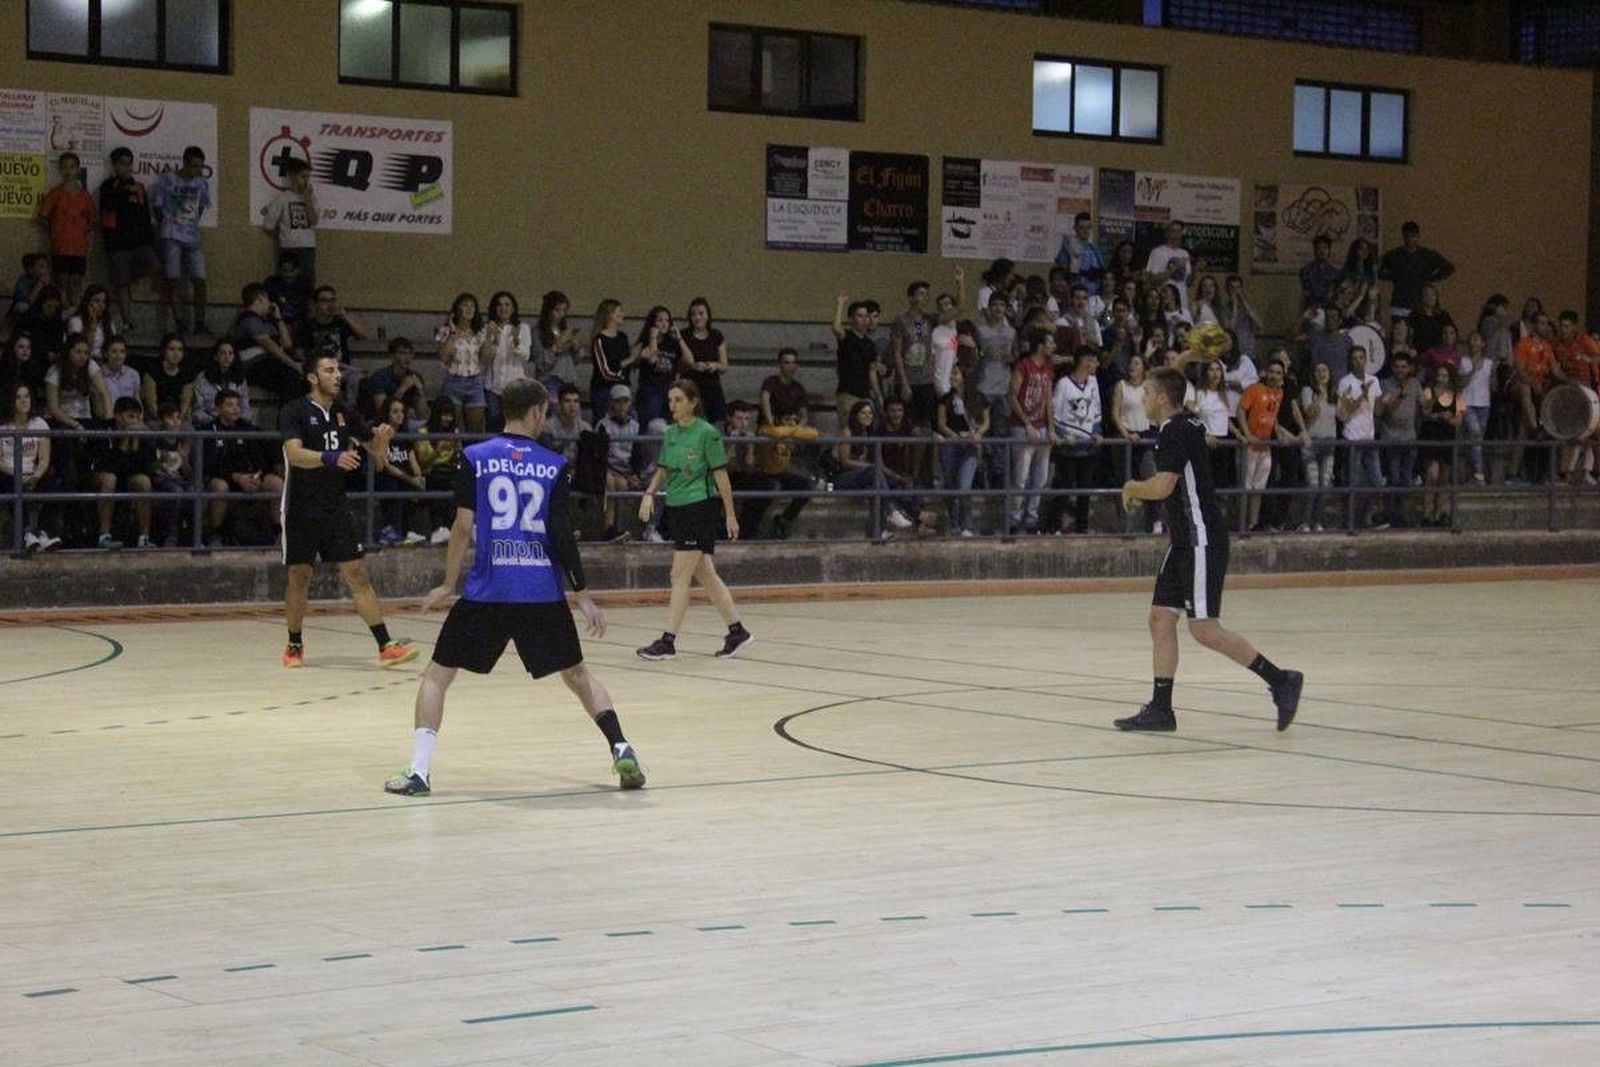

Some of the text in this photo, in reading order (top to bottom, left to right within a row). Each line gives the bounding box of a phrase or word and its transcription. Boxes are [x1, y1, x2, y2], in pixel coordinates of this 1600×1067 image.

[319, 124, 445, 143] TRANSPORTES
[343, 208, 368, 221] MÁS
[371, 211, 395, 223] QUE
[398, 213, 443, 225] PORTES
[323, 430, 340, 451] 15
[475, 458, 558, 479] J.DELGADO
[487, 475, 547, 534] 92
